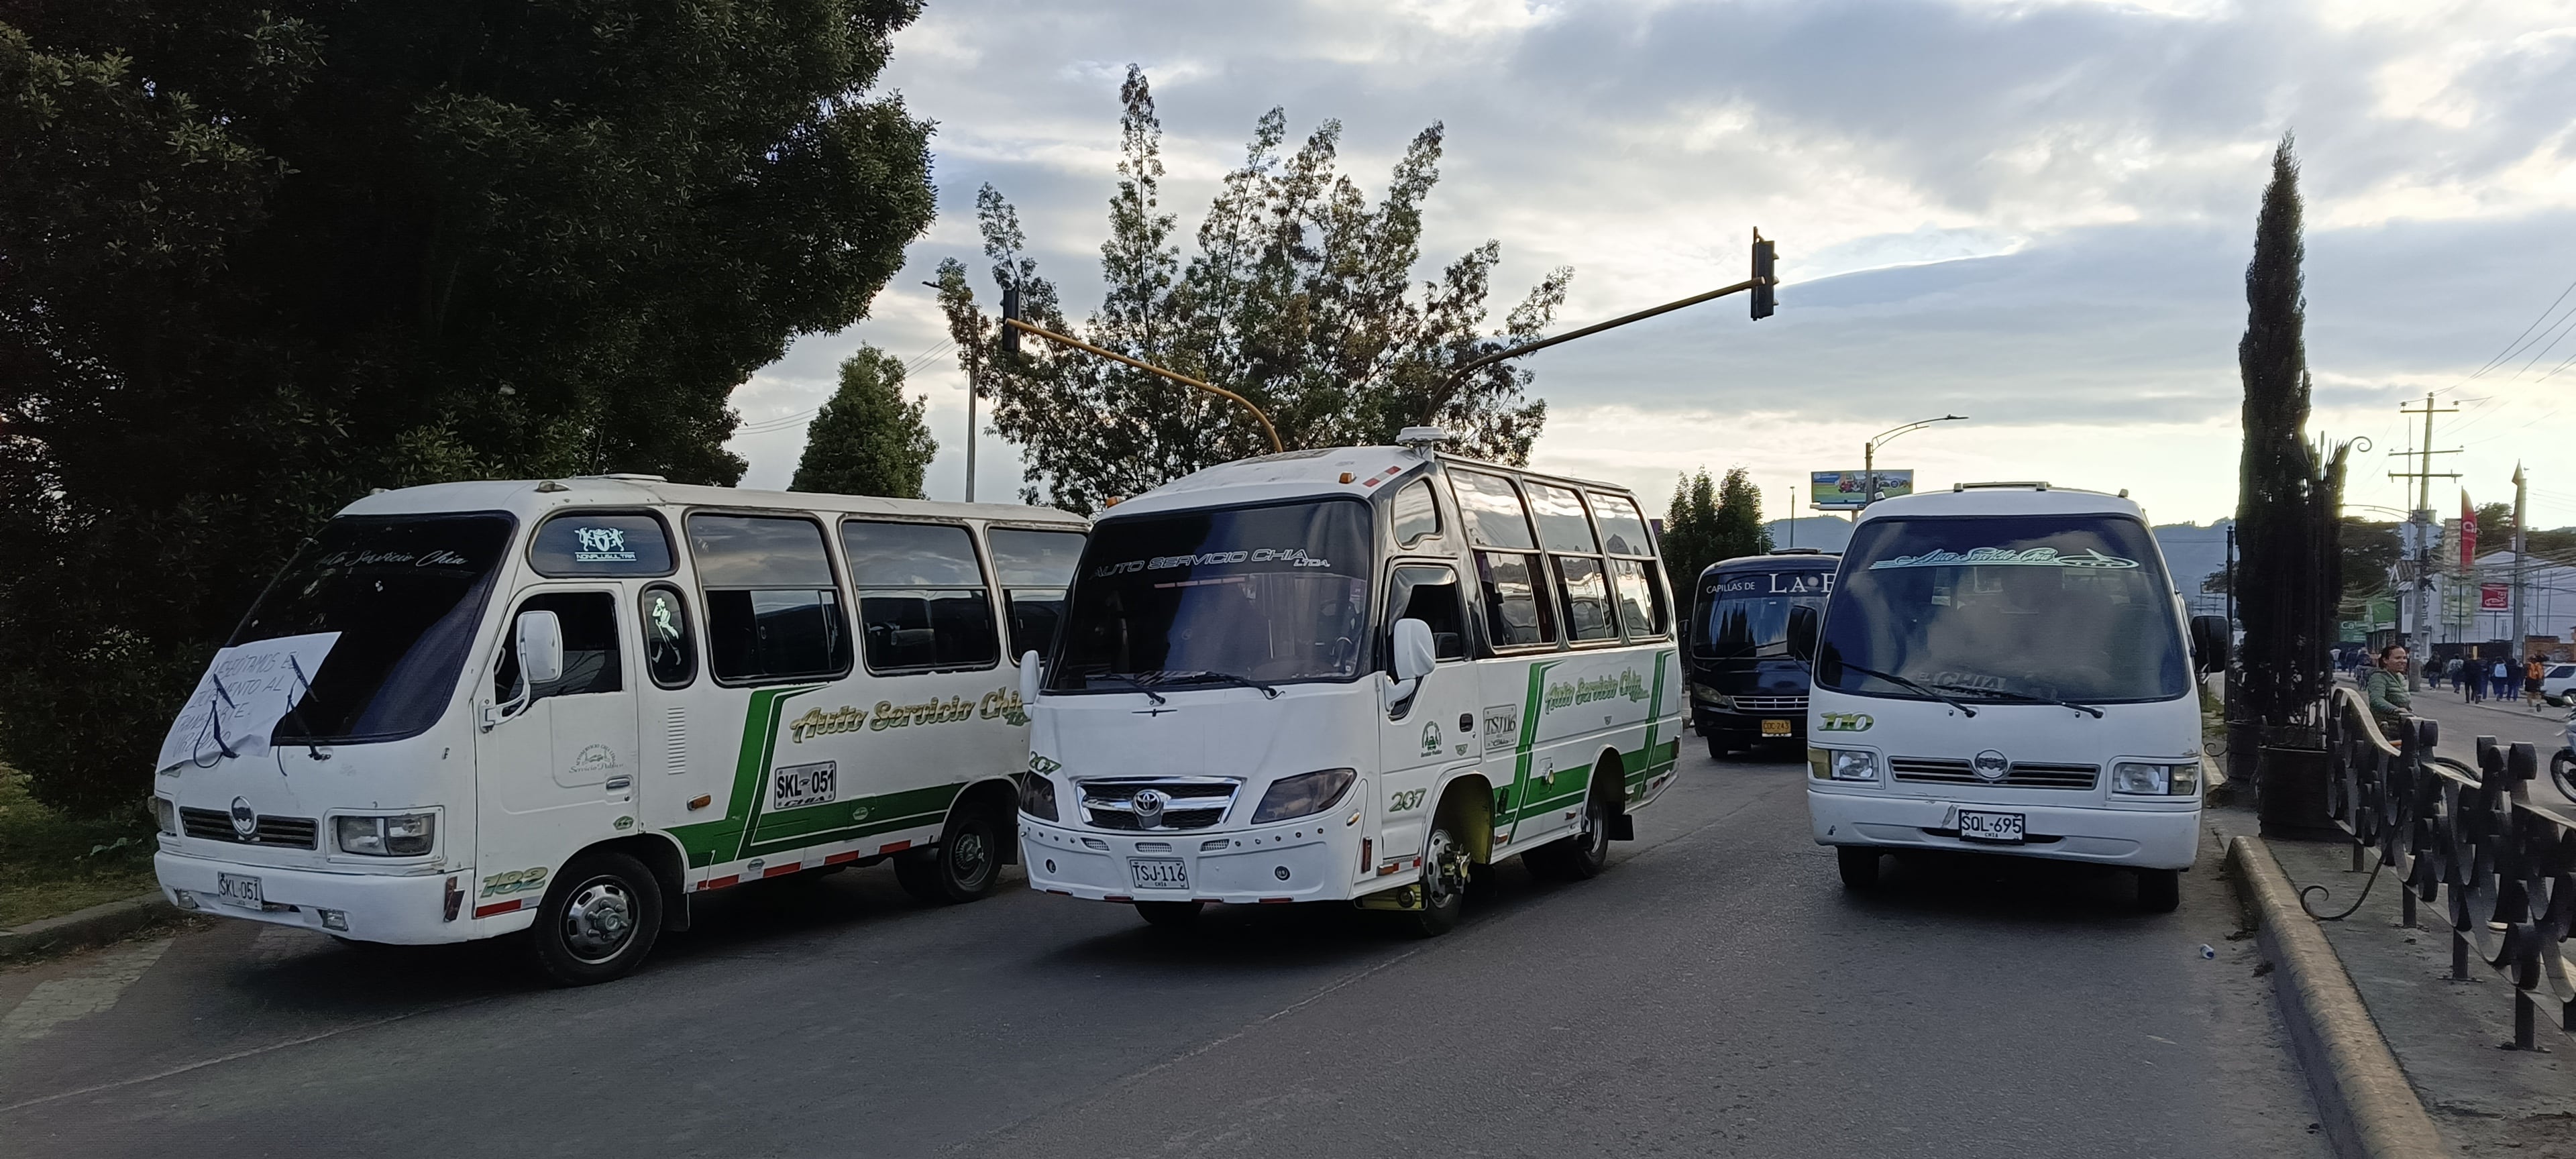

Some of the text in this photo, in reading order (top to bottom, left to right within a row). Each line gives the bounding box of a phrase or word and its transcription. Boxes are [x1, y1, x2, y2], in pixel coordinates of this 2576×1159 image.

[415, 550, 468, 567] Chia
[1148, 551, 1248, 570] SERVICIO
[1251, 548, 1308, 561] CHIA
[1706, 582, 1743, 594] CAPILLAS
[1744, 582, 1756, 590] DE
[262, 675, 284, 693] AL
[1544, 681, 1575, 715] Auto
[790, 704, 869, 744] Auto
[869, 695, 977, 732] Servicio
[979, 686, 1025, 720] Chi
[1817, 712, 1874, 732] 110
[1029, 751, 1062, 776] 207
[1389, 787, 1427, 813] 207
[480, 866, 549, 899] 182
